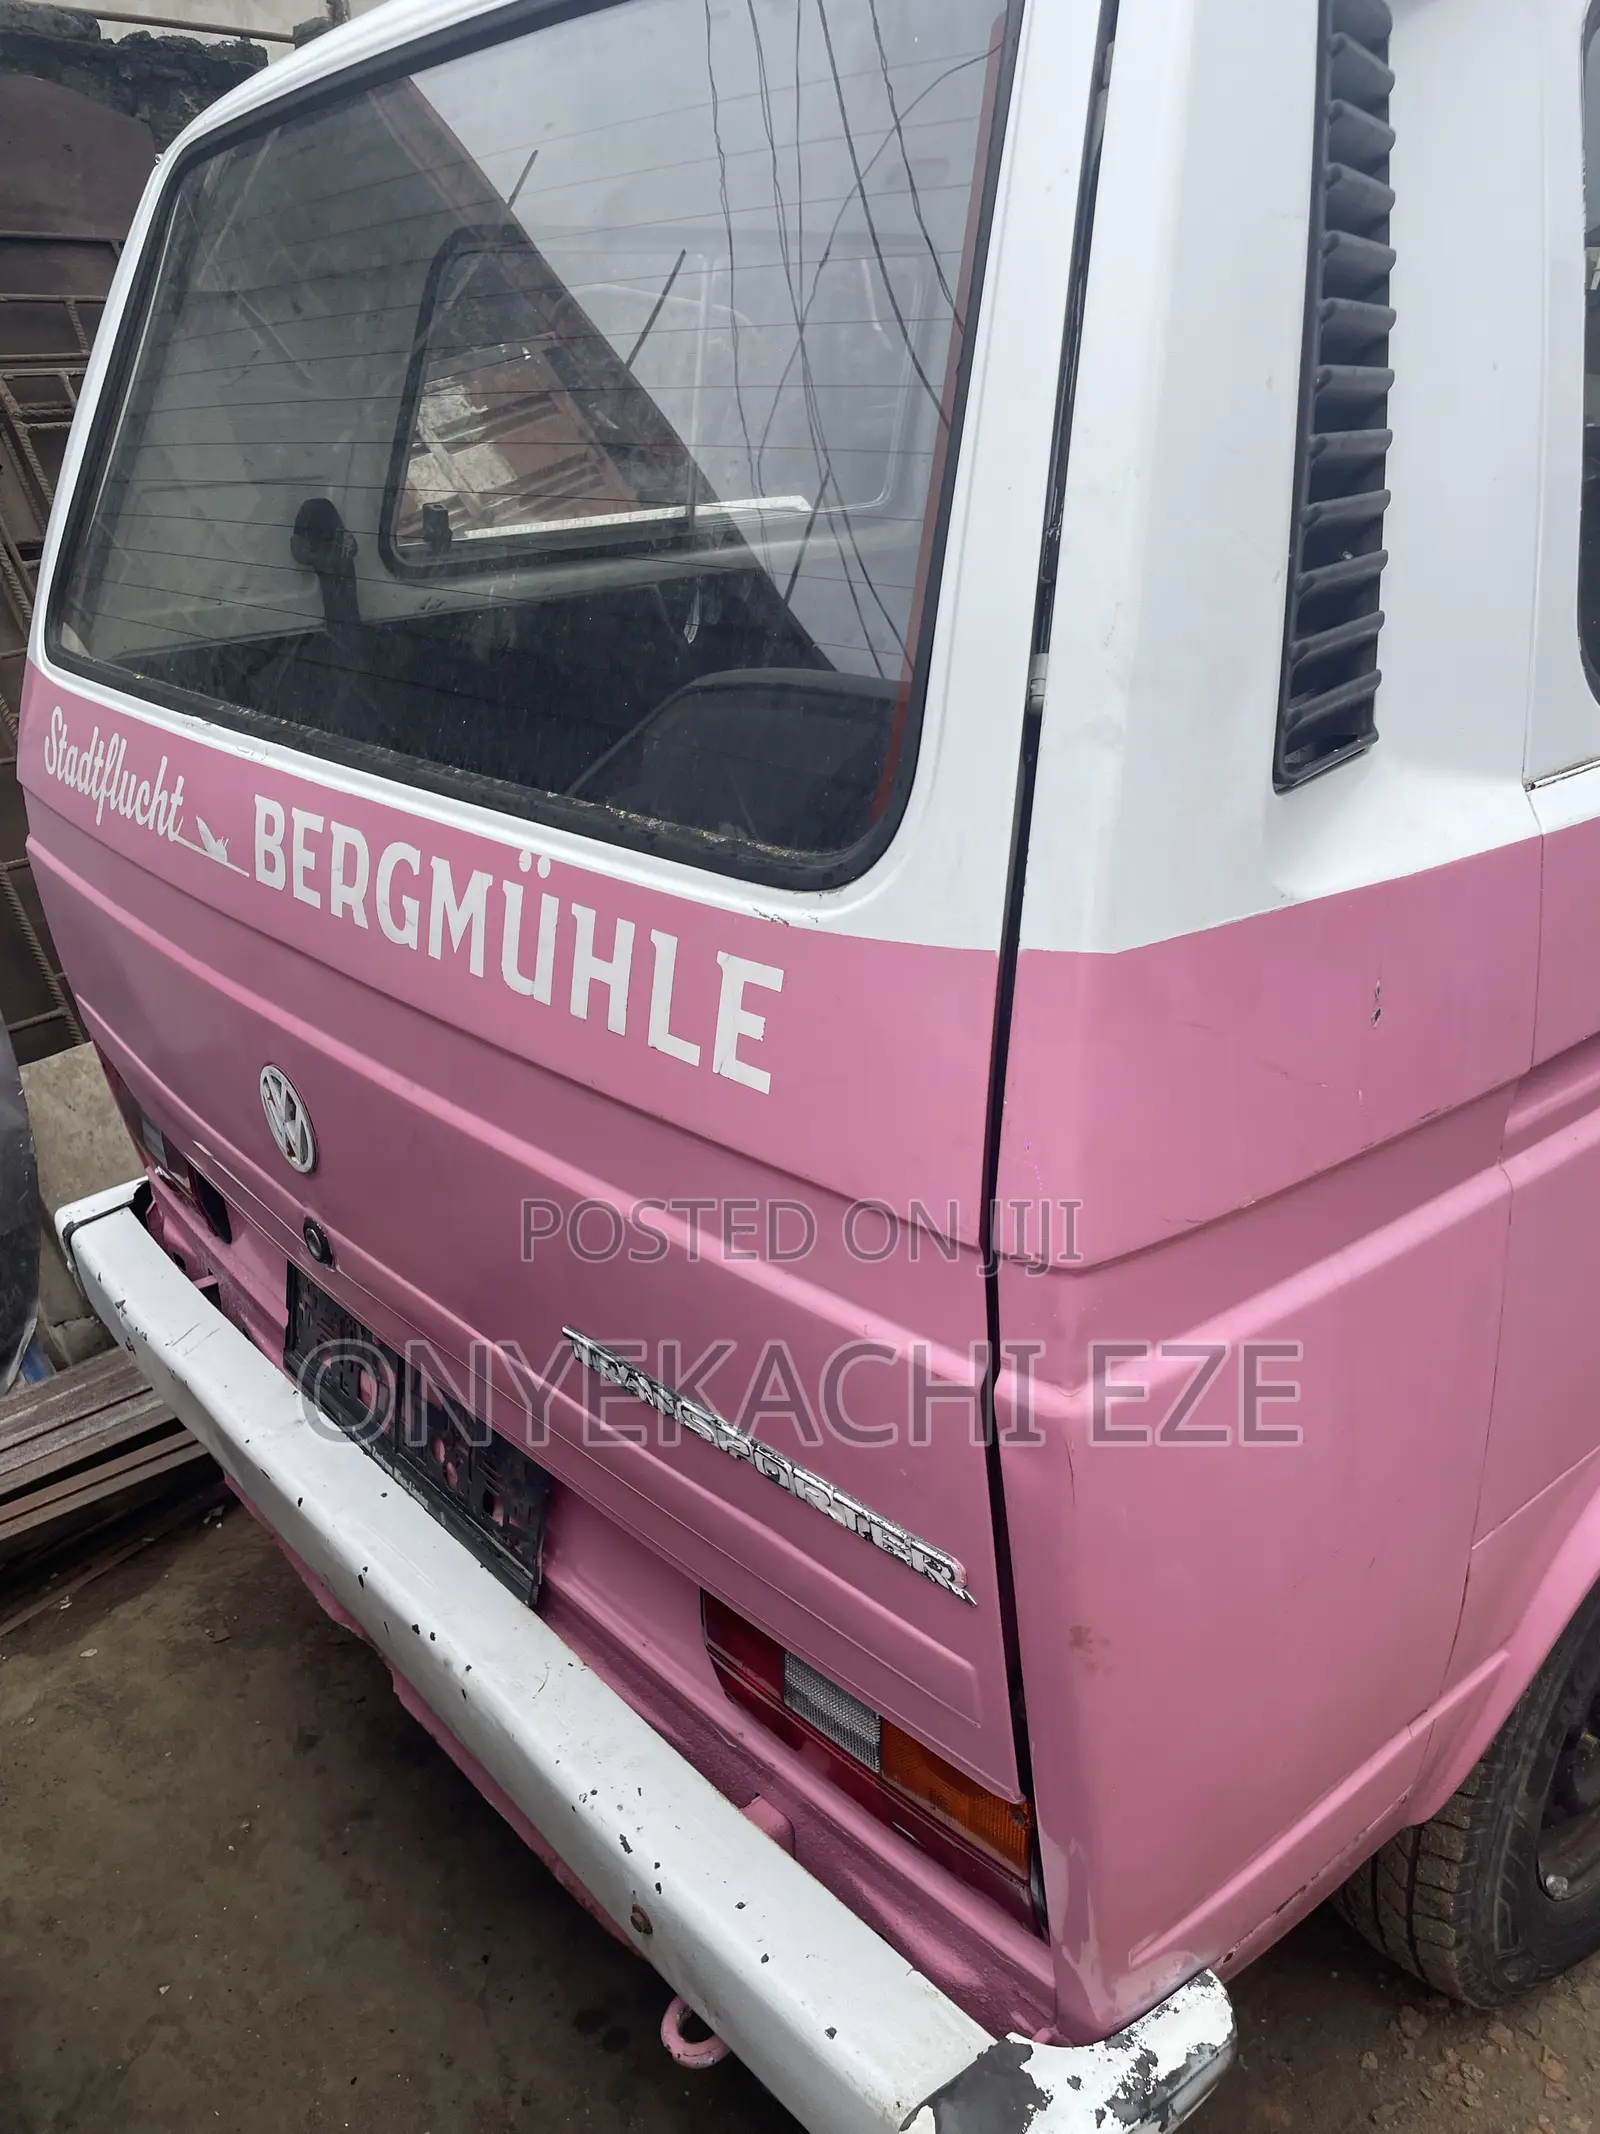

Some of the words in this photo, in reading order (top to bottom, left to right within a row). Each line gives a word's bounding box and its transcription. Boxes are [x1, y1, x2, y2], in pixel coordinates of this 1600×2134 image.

[44, 706, 184, 842] Stadtflucht
[254, 794, 785, 1095] BERGMÜHLE
[562, 1325, 978, 1606] TRANSPORTER
